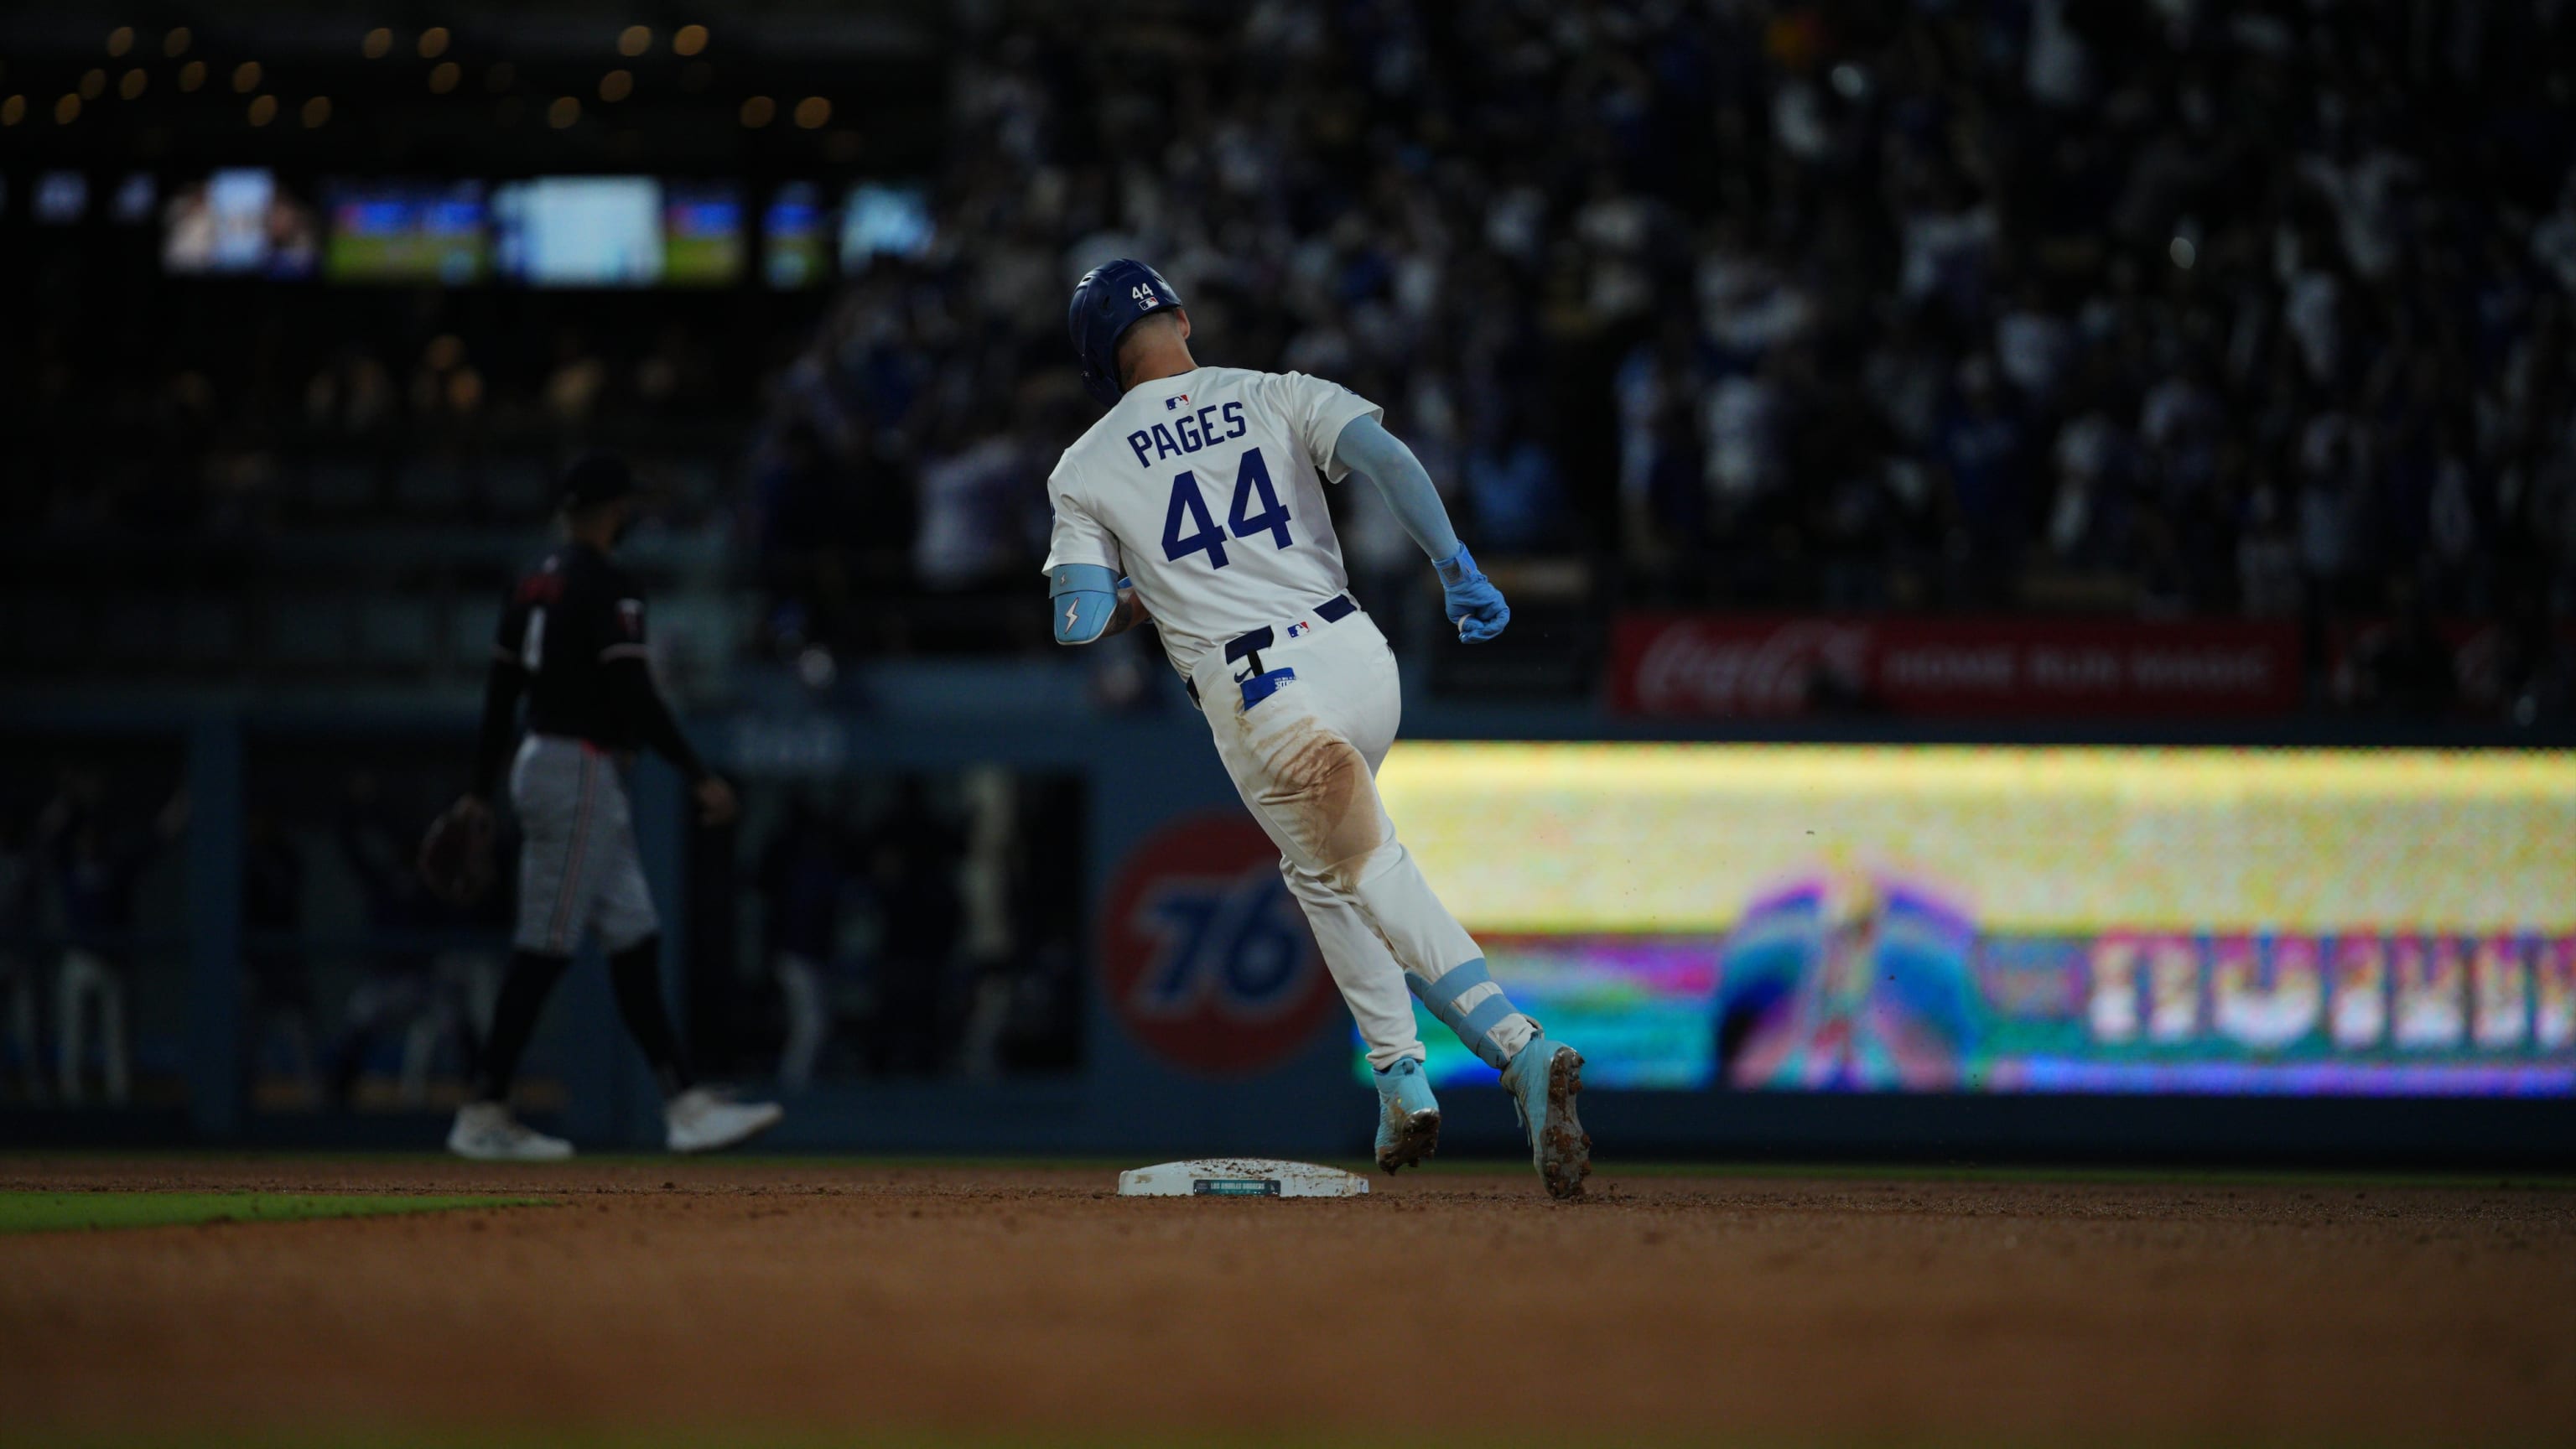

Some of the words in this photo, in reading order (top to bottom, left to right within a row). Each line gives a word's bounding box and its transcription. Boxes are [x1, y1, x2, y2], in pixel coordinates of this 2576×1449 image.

[1132, 283, 1153, 300] 44
[1127, 402, 1246, 469] PAGES
[1161, 446, 1292, 570] 44
[1142, 874, 1302, 1009] 76
